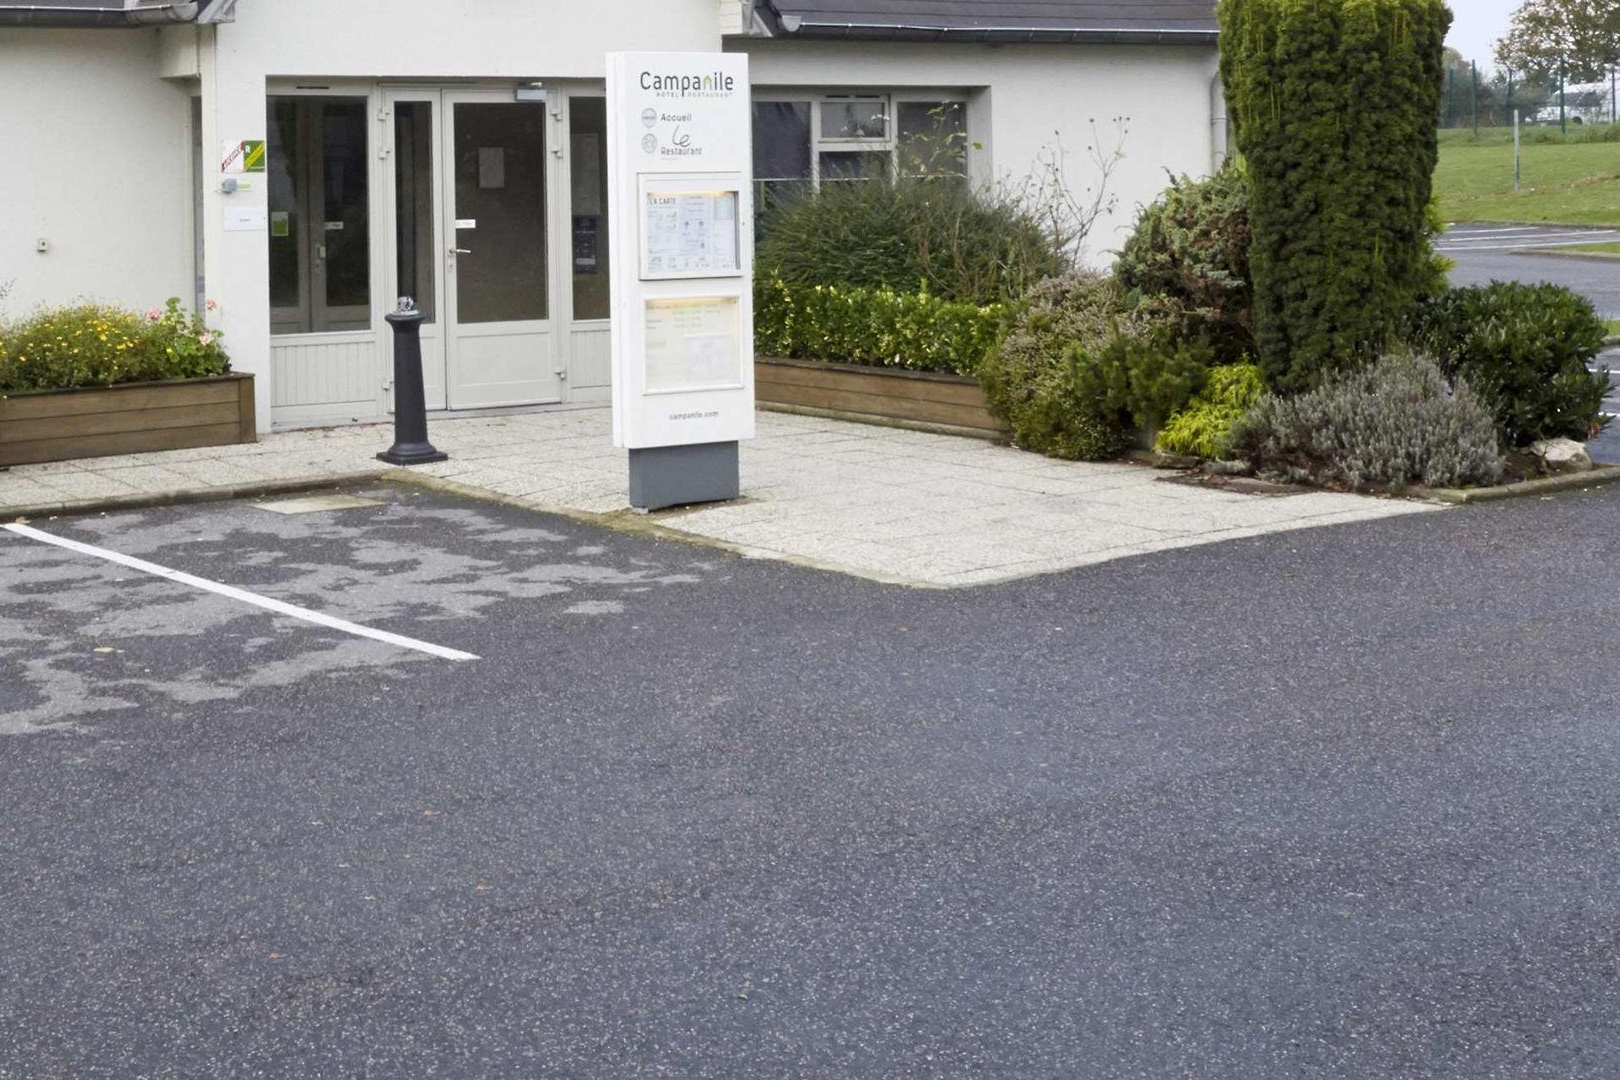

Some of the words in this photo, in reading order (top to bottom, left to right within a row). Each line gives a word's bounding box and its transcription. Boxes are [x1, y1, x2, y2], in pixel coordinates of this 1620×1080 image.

[640, 71, 734, 98] Campanile
[661, 113, 692, 122] Accueil
[660, 146, 702, 156] Restaurant
